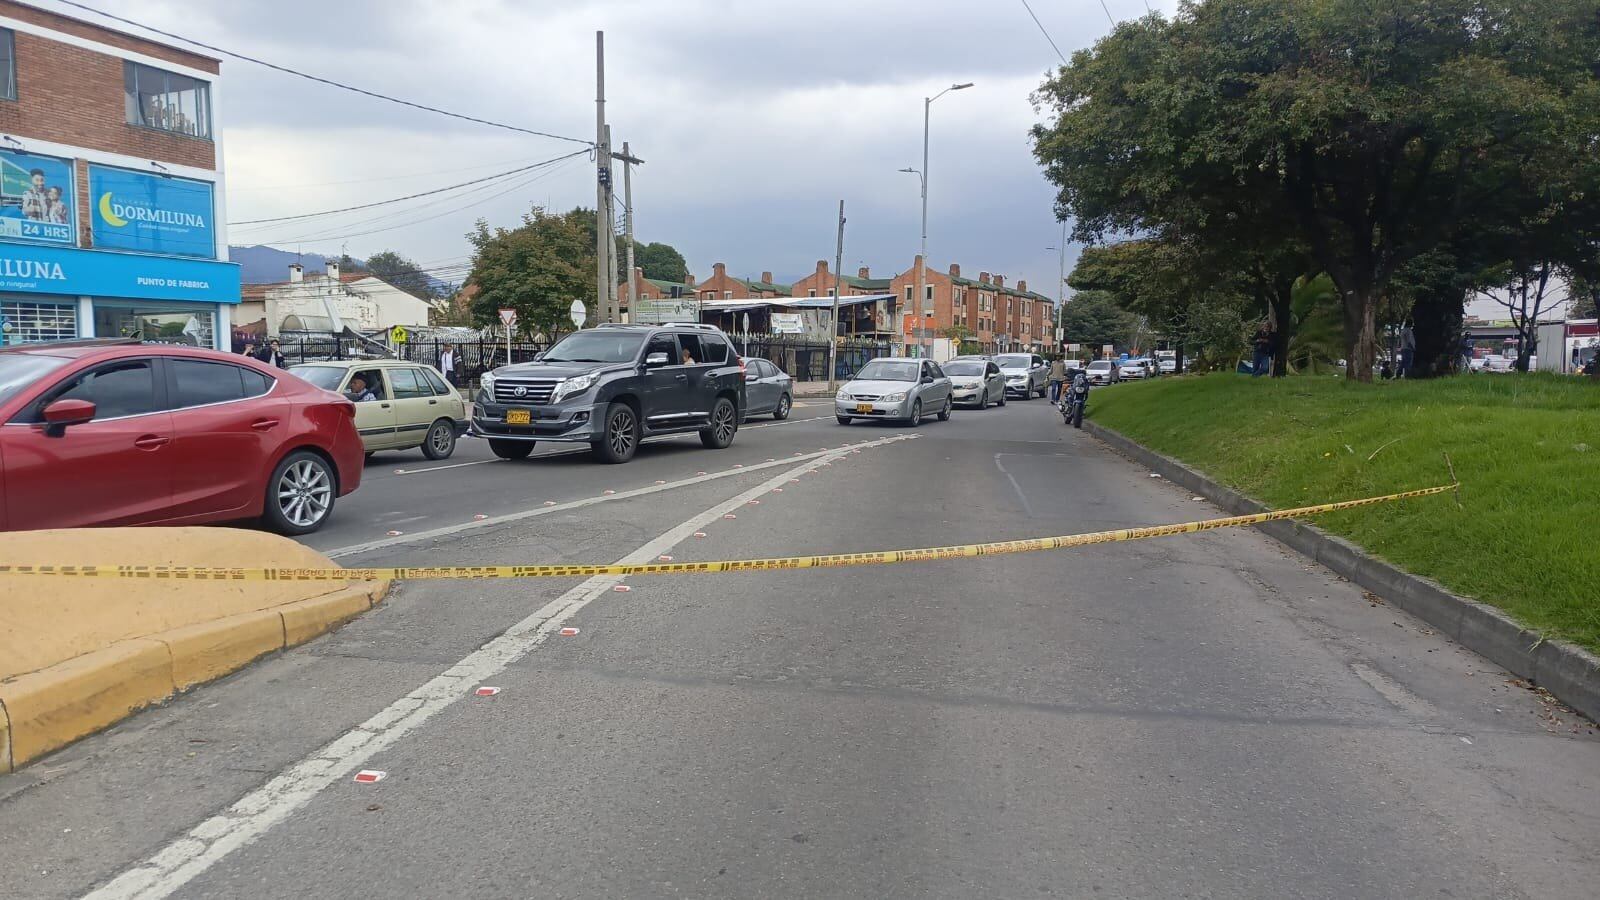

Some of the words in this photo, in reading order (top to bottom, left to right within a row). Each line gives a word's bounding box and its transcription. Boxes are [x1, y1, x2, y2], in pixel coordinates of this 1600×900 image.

[113, 203, 205, 228] DORMILUNA
[24, 224, 39, 235] 24
[43, 226, 69, 238] HRS
[137, 277, 166, 287] PUNTO
[167, 279, 178, 287] DE
[178, 280, 209, 289] FABRICA
